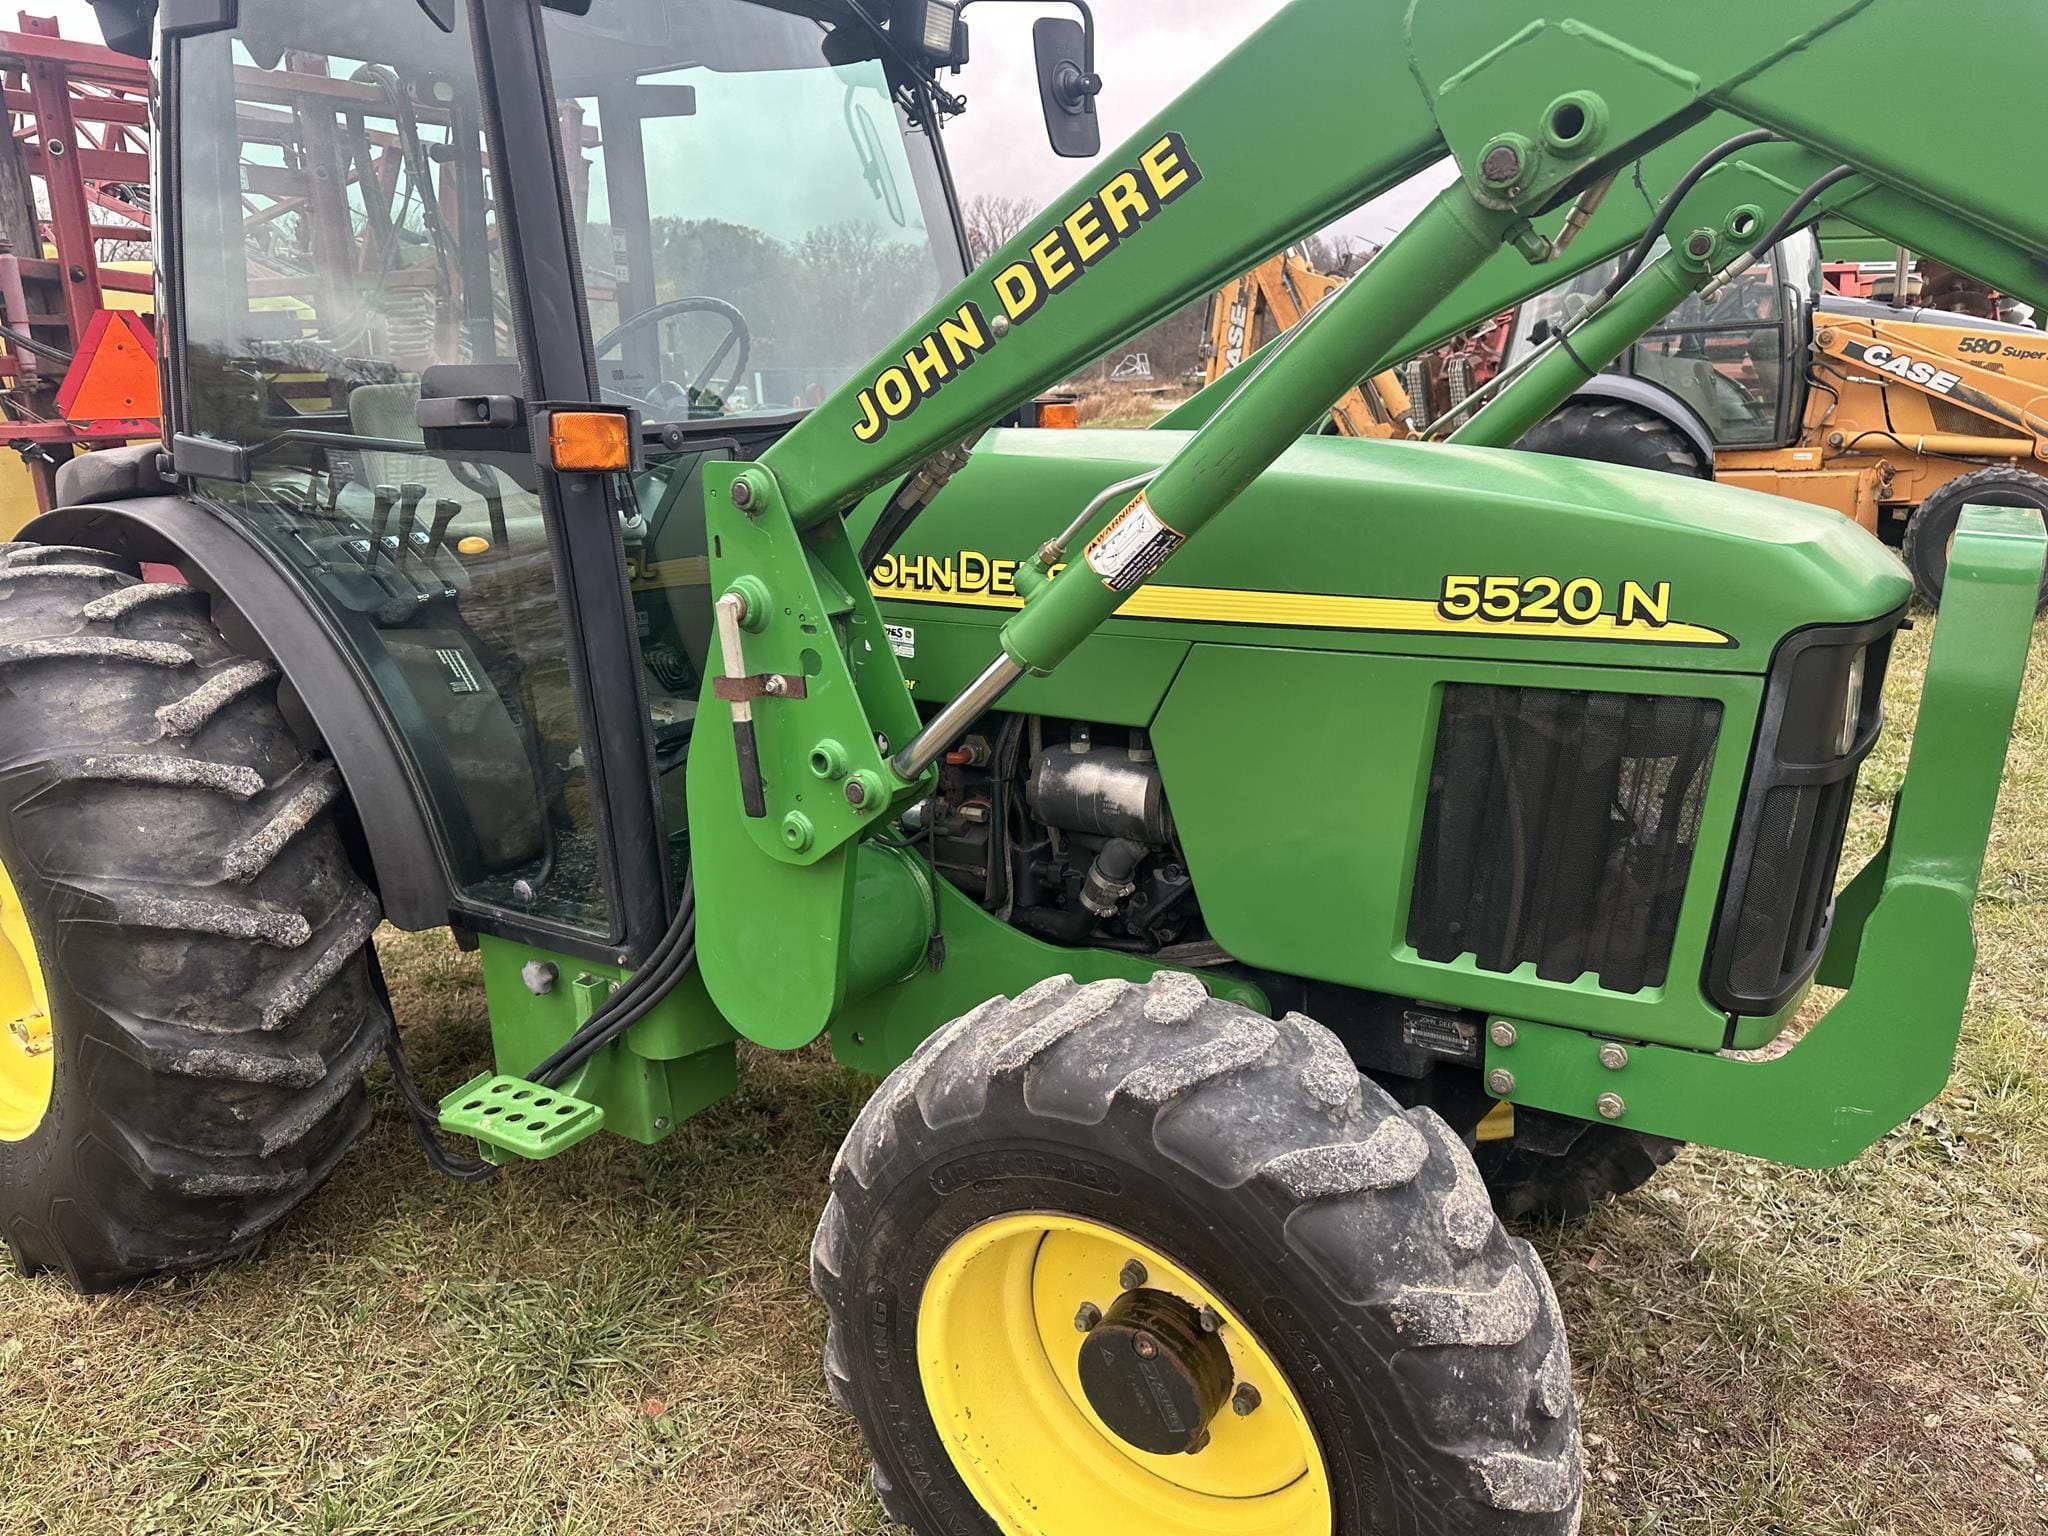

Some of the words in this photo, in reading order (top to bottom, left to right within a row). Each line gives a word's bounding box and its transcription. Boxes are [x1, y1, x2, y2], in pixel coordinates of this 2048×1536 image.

[852, 303, 995, 444] JOHN
[992, 132, 1203, 325] DEERE
[1223, 301, 1247, 375] ASE
[1958, 336, 2001, 354] 580
[2002, 346, 2046, 360] Super
[1863, 344, 1963, 394] CASE
[1096, 494, 1143, 543] WARNING
[872, 552, 951, 592] OHN
[1438, 575, 1602, 624] 5520
[1615, 580, 1671, 627] N
[872, 1301, 893, 1382] KING
